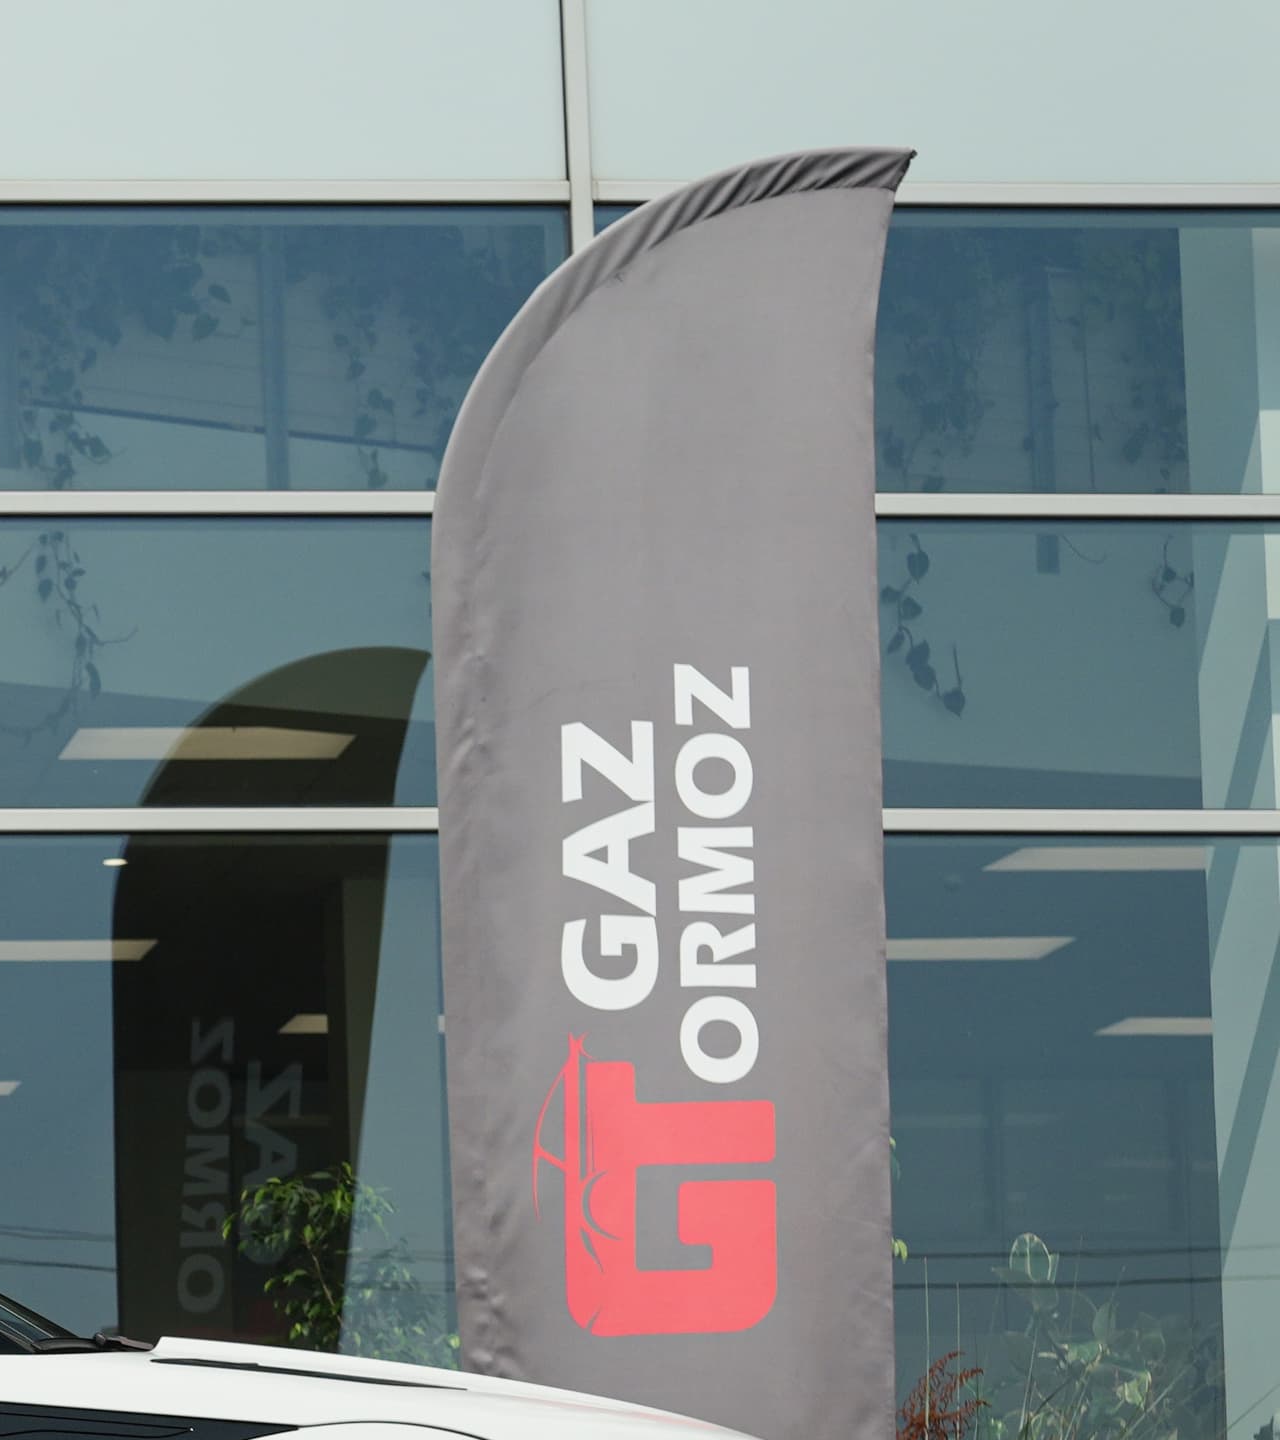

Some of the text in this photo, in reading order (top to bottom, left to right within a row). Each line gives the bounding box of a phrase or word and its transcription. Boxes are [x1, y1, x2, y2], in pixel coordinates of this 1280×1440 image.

[561, 720, 659, 1011] GAZ
[674, 663, 759, 1083] ORMOZ
[565, 1060, 778, 1338] GT
